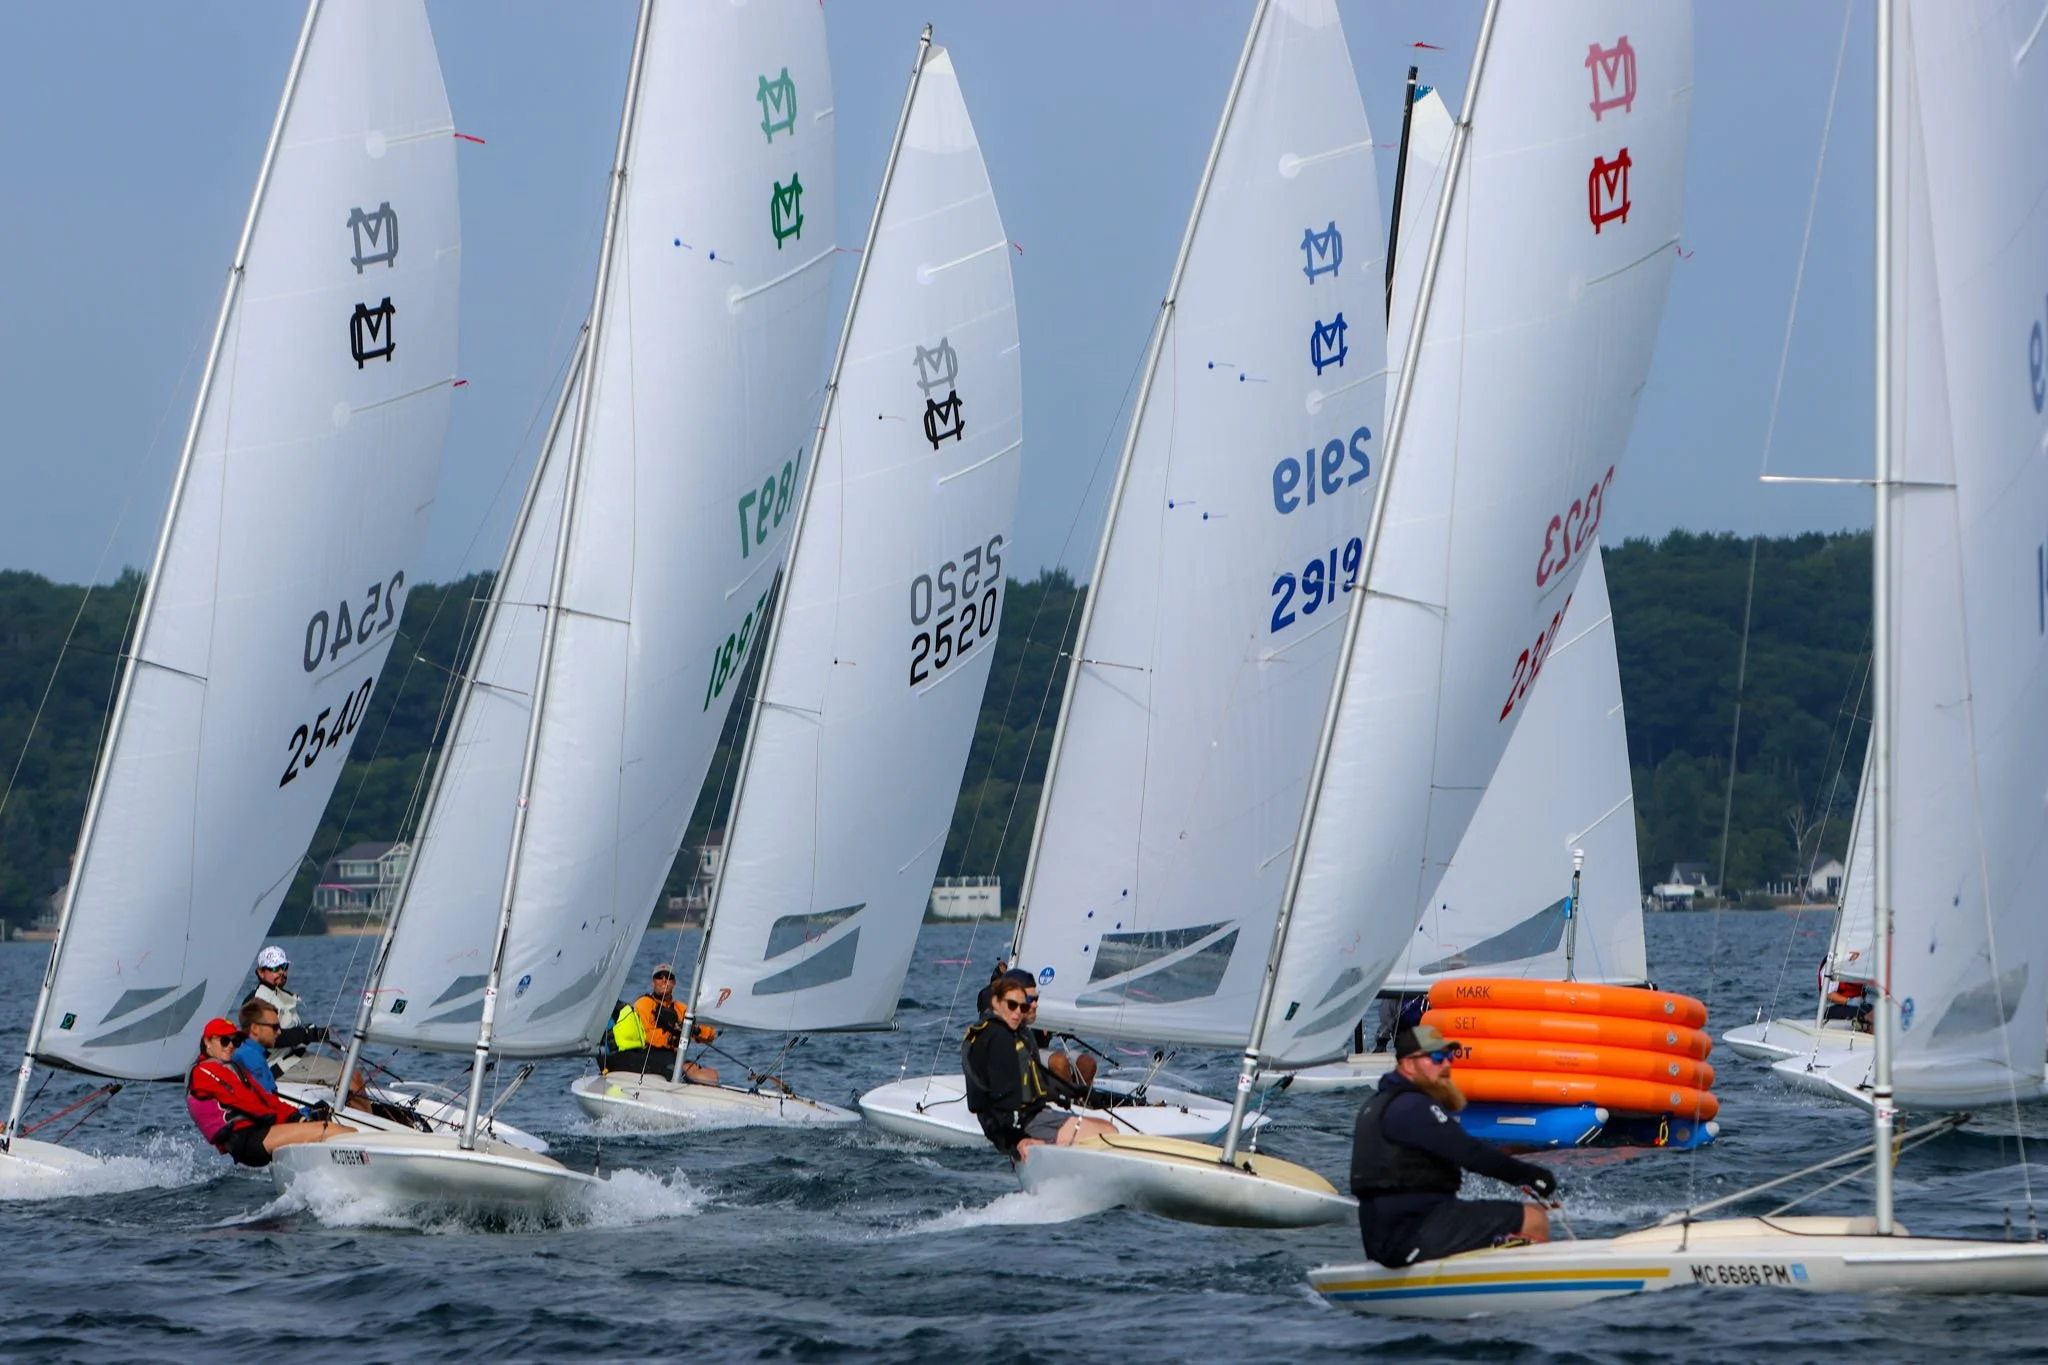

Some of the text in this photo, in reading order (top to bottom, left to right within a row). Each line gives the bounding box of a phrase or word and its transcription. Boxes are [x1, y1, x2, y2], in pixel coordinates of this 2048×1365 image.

[1271, 537, 1363, 633] 2919
[704, 589, 768, 712] 1897
[910, 587, 997, 687] 2520
[279, 676, 373, 788] 2540
[1456, 985, 1491, 999] MARK
[1455, 1016, 1477, 1030] SET
[1454, 1047, 1472, 1060] OT
[1690, 1264, 1791, 1285] MC 6686 PM
